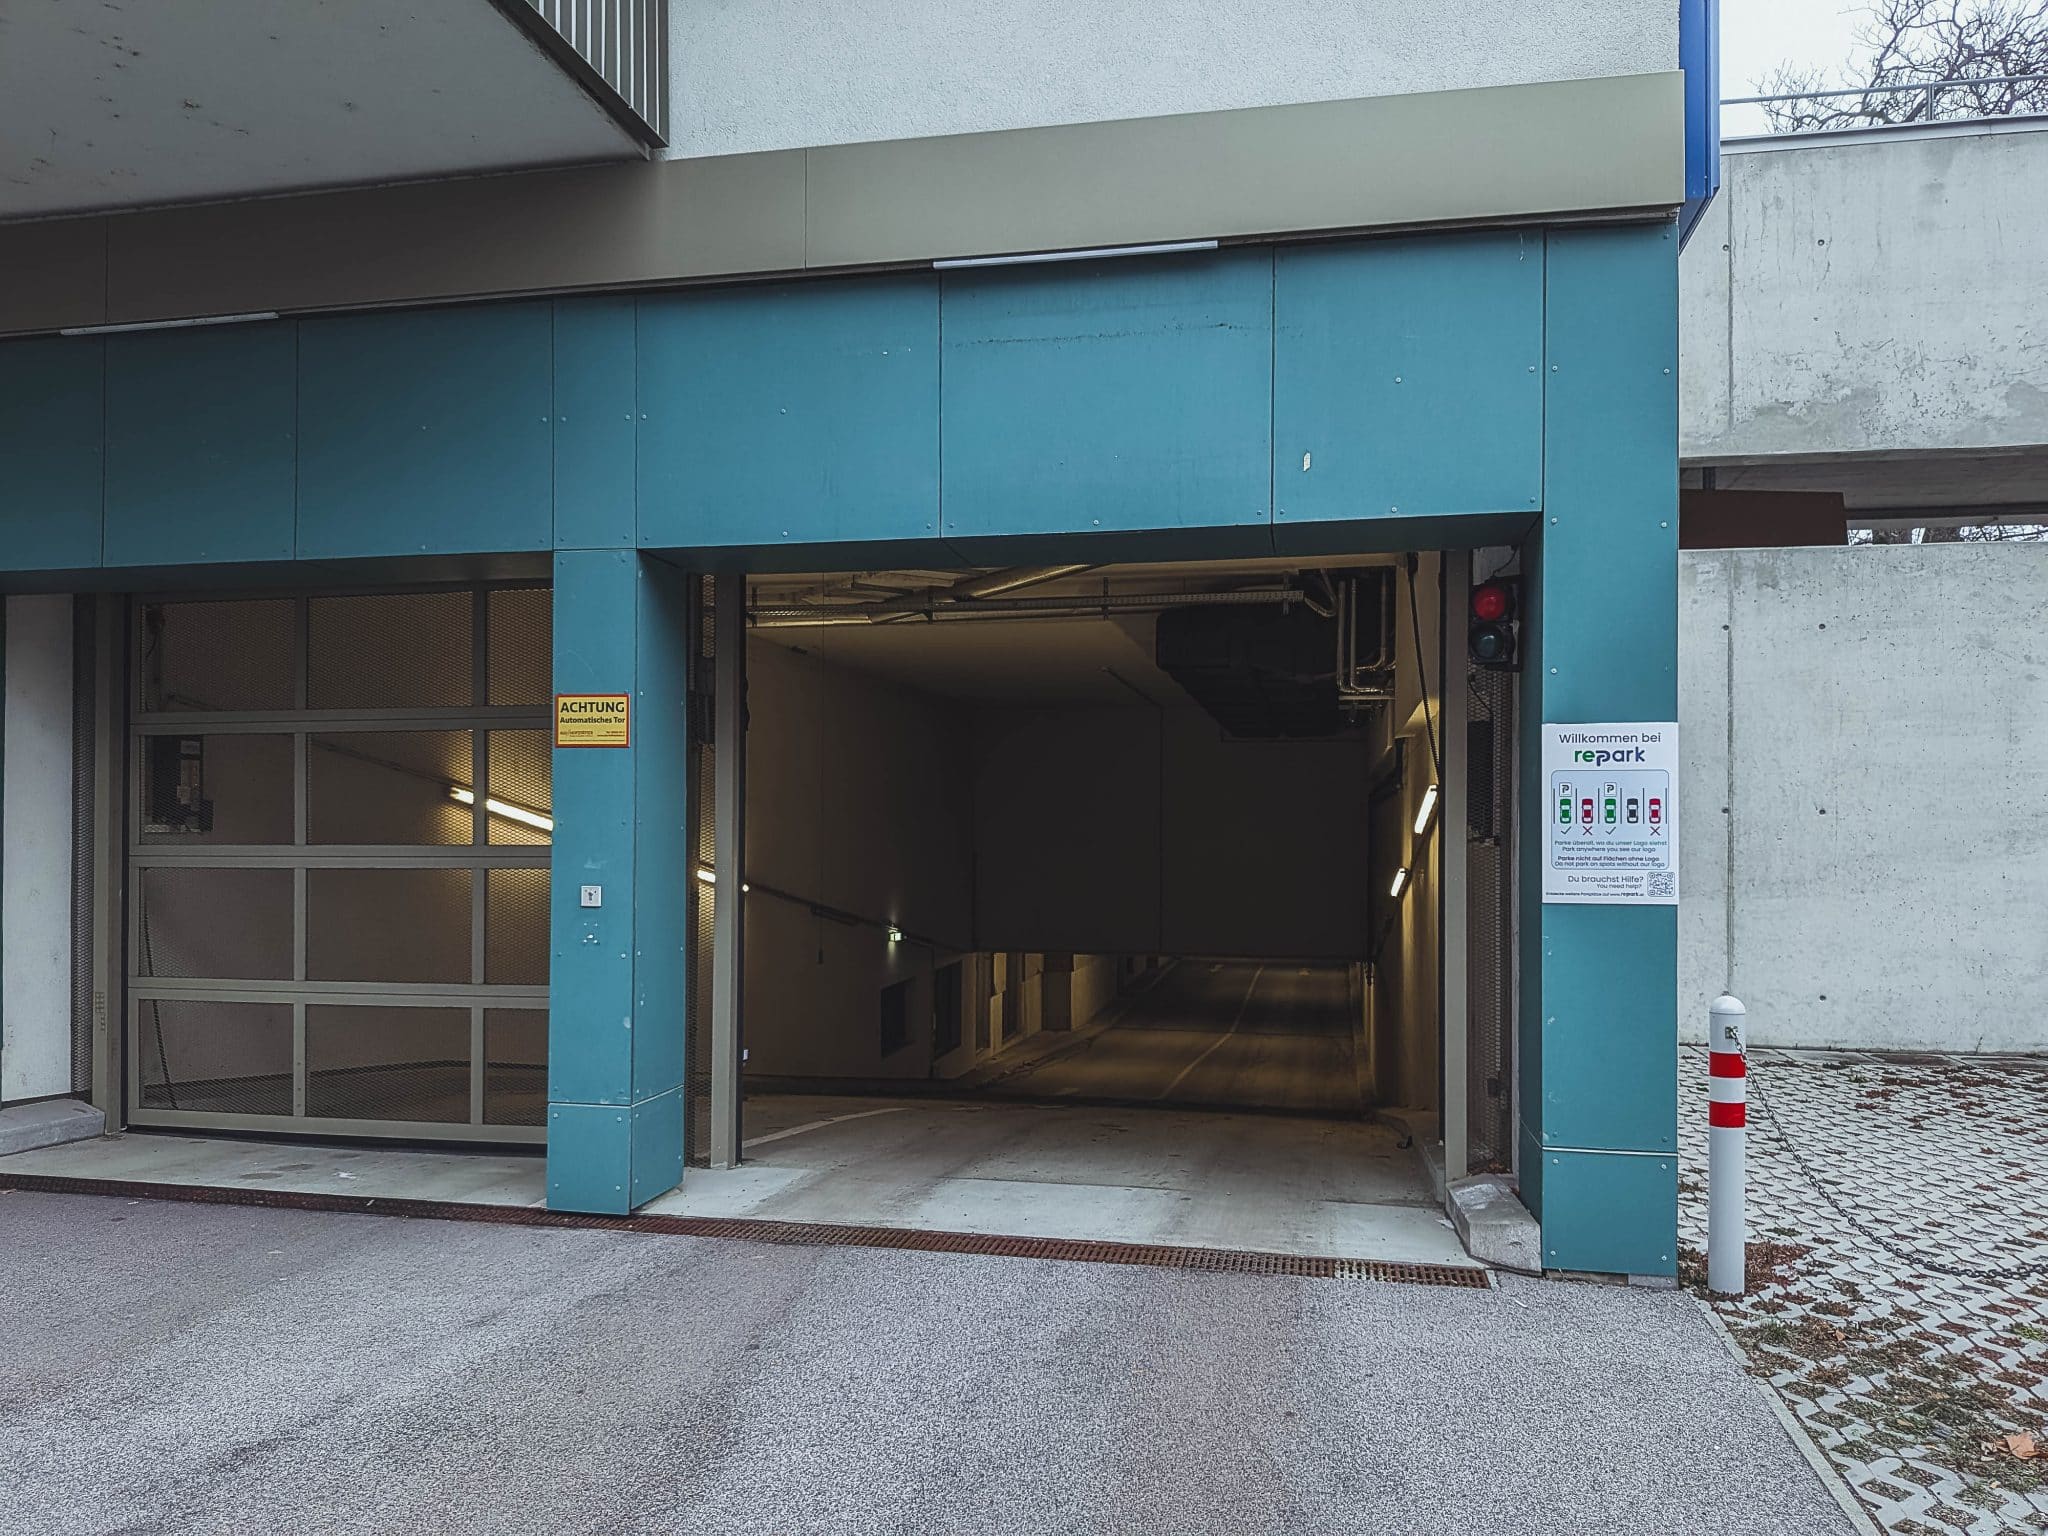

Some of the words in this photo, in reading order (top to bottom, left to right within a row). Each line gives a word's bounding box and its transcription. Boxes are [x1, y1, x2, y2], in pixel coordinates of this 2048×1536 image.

[560, 702, 625, 713] ACHTUNG
[560, 716, 613, 724] Automatisches
[1559, 733, 1638, 744] Willkommen
[1641, 732, 1662, 743] bei
[1574, 746, 1646, 767] repark
[1567, 875, 1580, 883] Du
[1581, 875, 1619, 883] brauchst
[1621, 875, 1644, 883] Hilfe?
